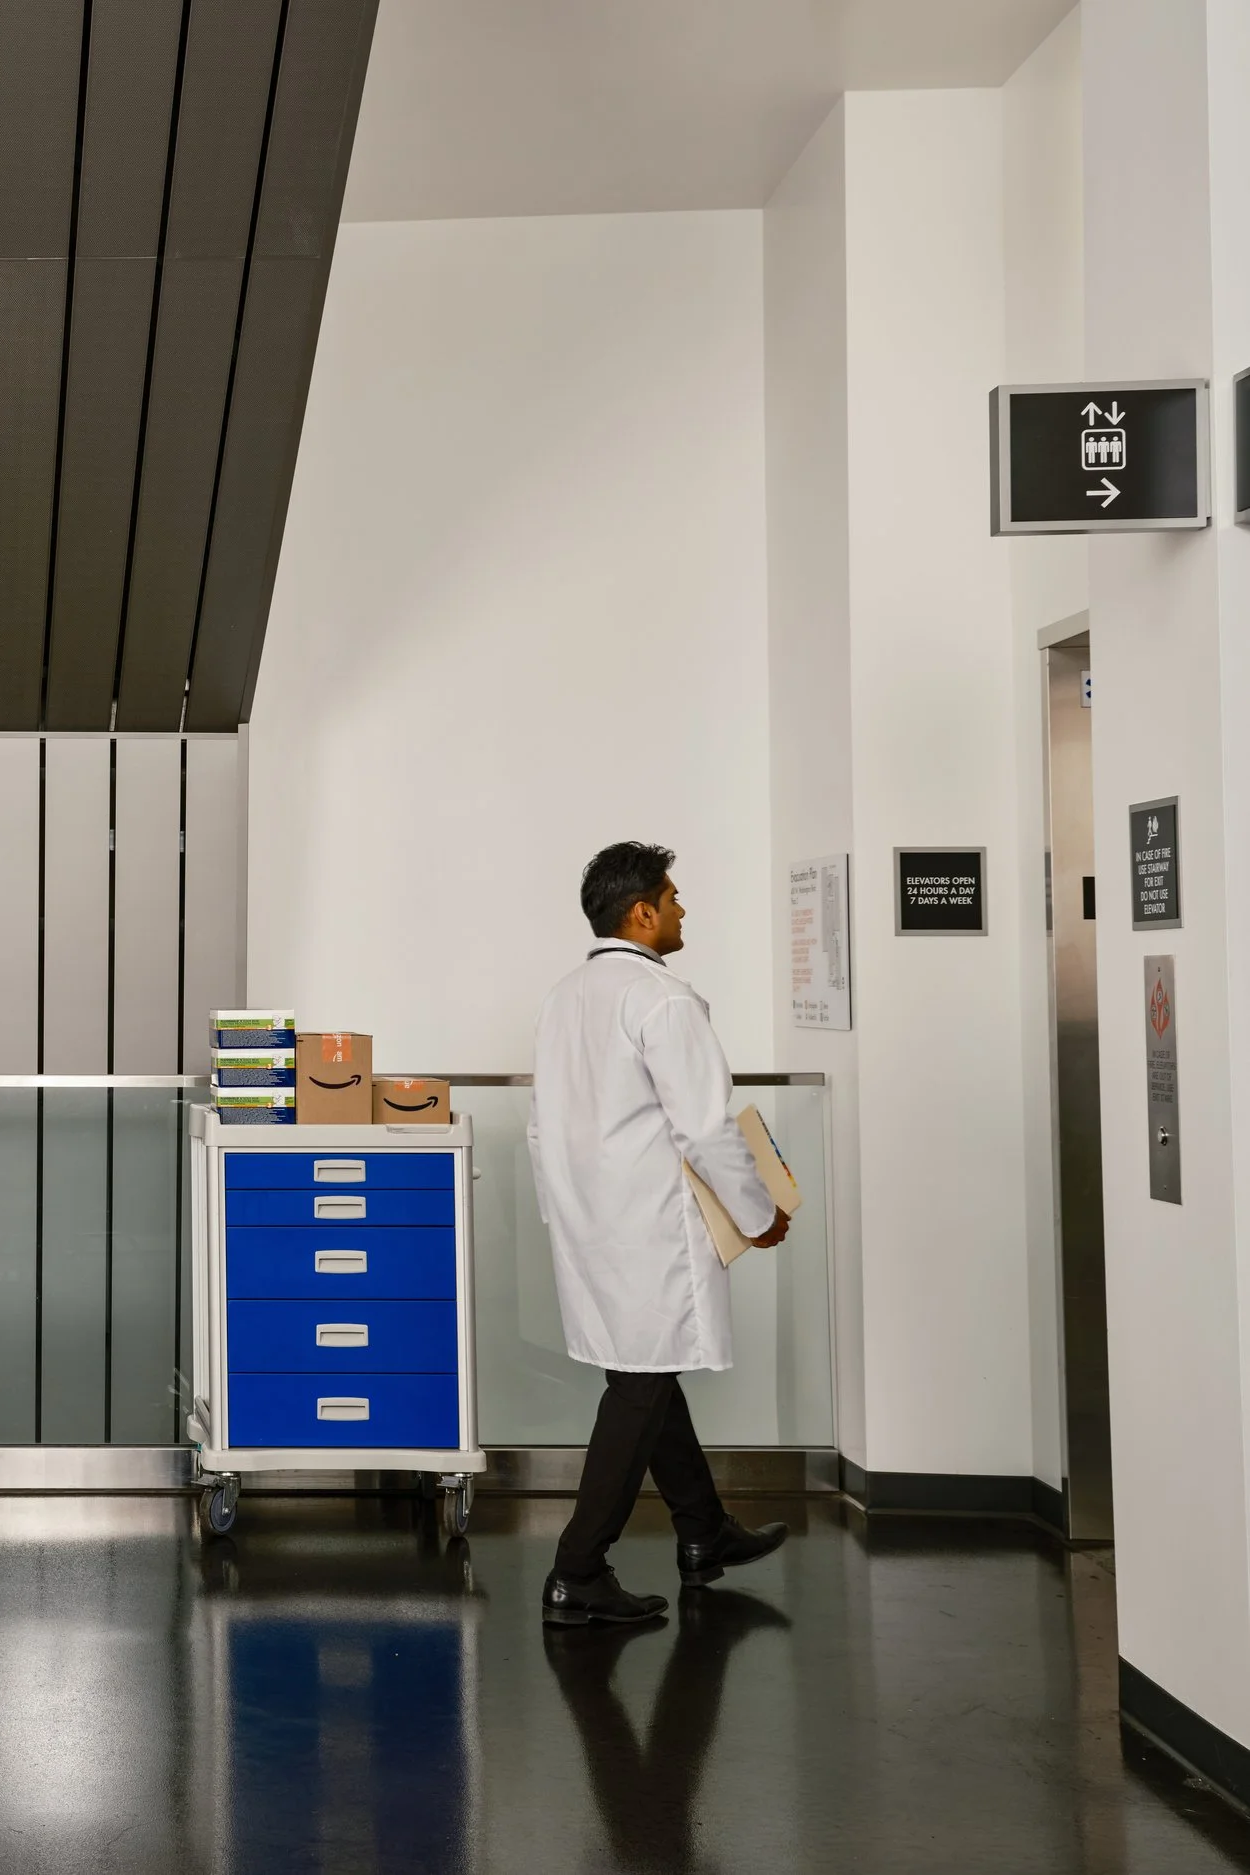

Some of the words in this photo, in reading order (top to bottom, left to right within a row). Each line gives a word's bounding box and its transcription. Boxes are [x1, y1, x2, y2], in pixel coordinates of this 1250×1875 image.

[1135, 851, 1141, 862] IN
[1141, 850, 1154, 861] CASE
[1154, 848, 1161, 860] OF
[1161, 847, 1171, 858] FIRE
[1137, 864, 1147, 875] USE
[1147, 862, 1169, 873] STAIRWAY
[906, 877, 950, 885] ELEVATORS
[952, 877, 976, 885] OPEN
[1144, 876, 1154, 888] FOR
[1154, 875, 1164, 887] EXIT
[907, 887, 918, 895] 24
[919, 887, 949, 895] HOURS
[950, 887, 957, 895] A
[959, 887, 976, 895] DAY
[1140, 891, 1148, 902] DO
[1148, 889, 1159, 901] NOT
[1159, 888, 1168, 900] USE
[910, 897, 916, 905] 7
[918, 897, 939, 905] DAYS
[940, 897, 947, 905] A
[949, 897, 973, 905] WEEK
[1144, 903, 1165, 915] ELEVATOR
